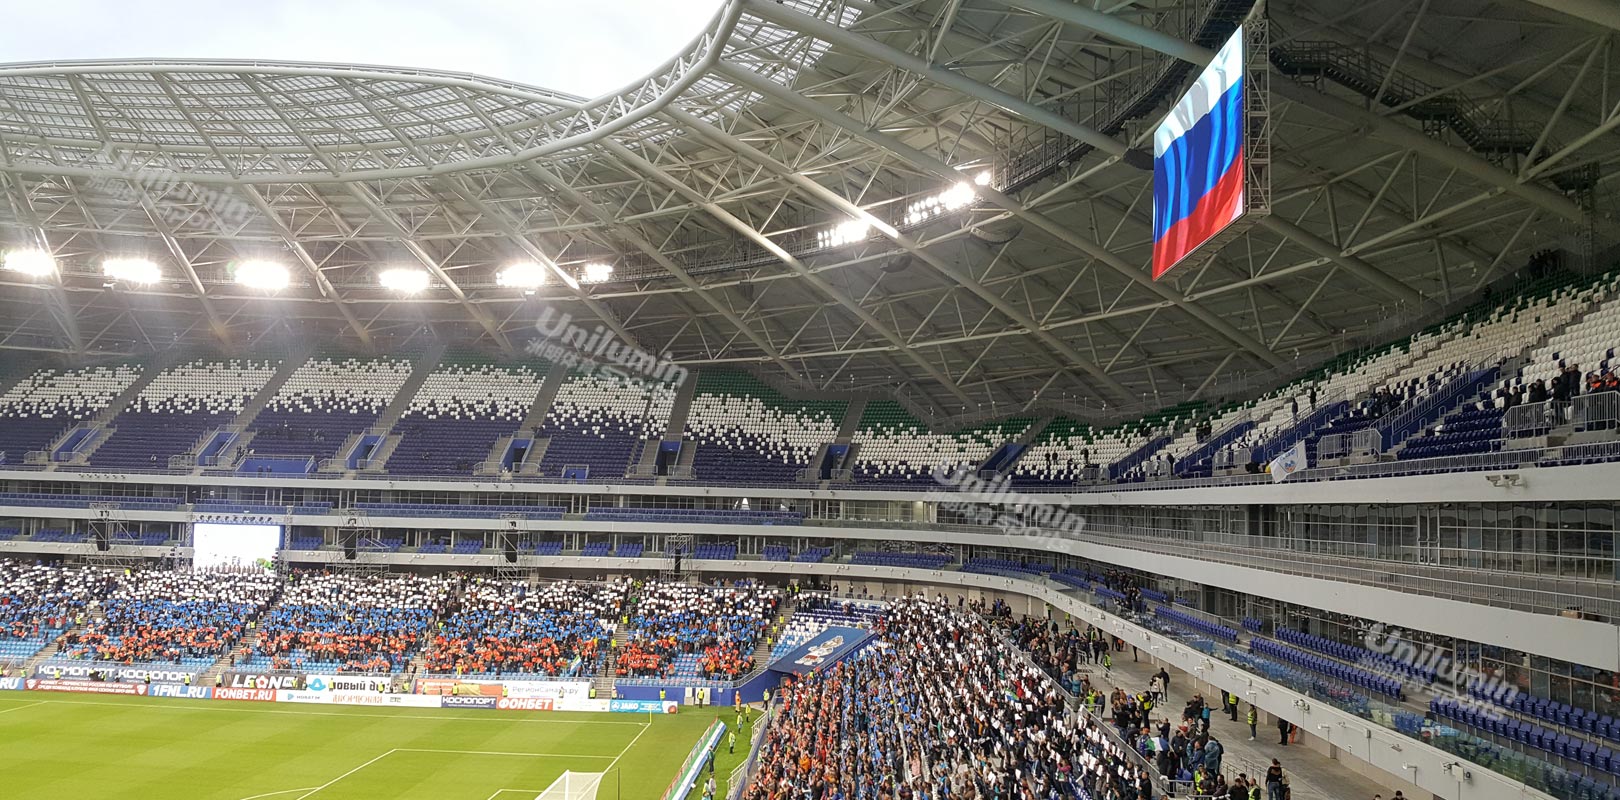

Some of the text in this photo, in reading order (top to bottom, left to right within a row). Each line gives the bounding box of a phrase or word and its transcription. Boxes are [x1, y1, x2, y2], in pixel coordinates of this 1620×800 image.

[38, 666, 115, 678] КОМОПРТ
[153, 685, 207, 698] 1FNL.RU
[215, 688, 273, 700] FONBET.RU
[442, 697, 496, 705] КОСМОПОРТ
[498, 698, 553, 711] ФОНБЕТ
